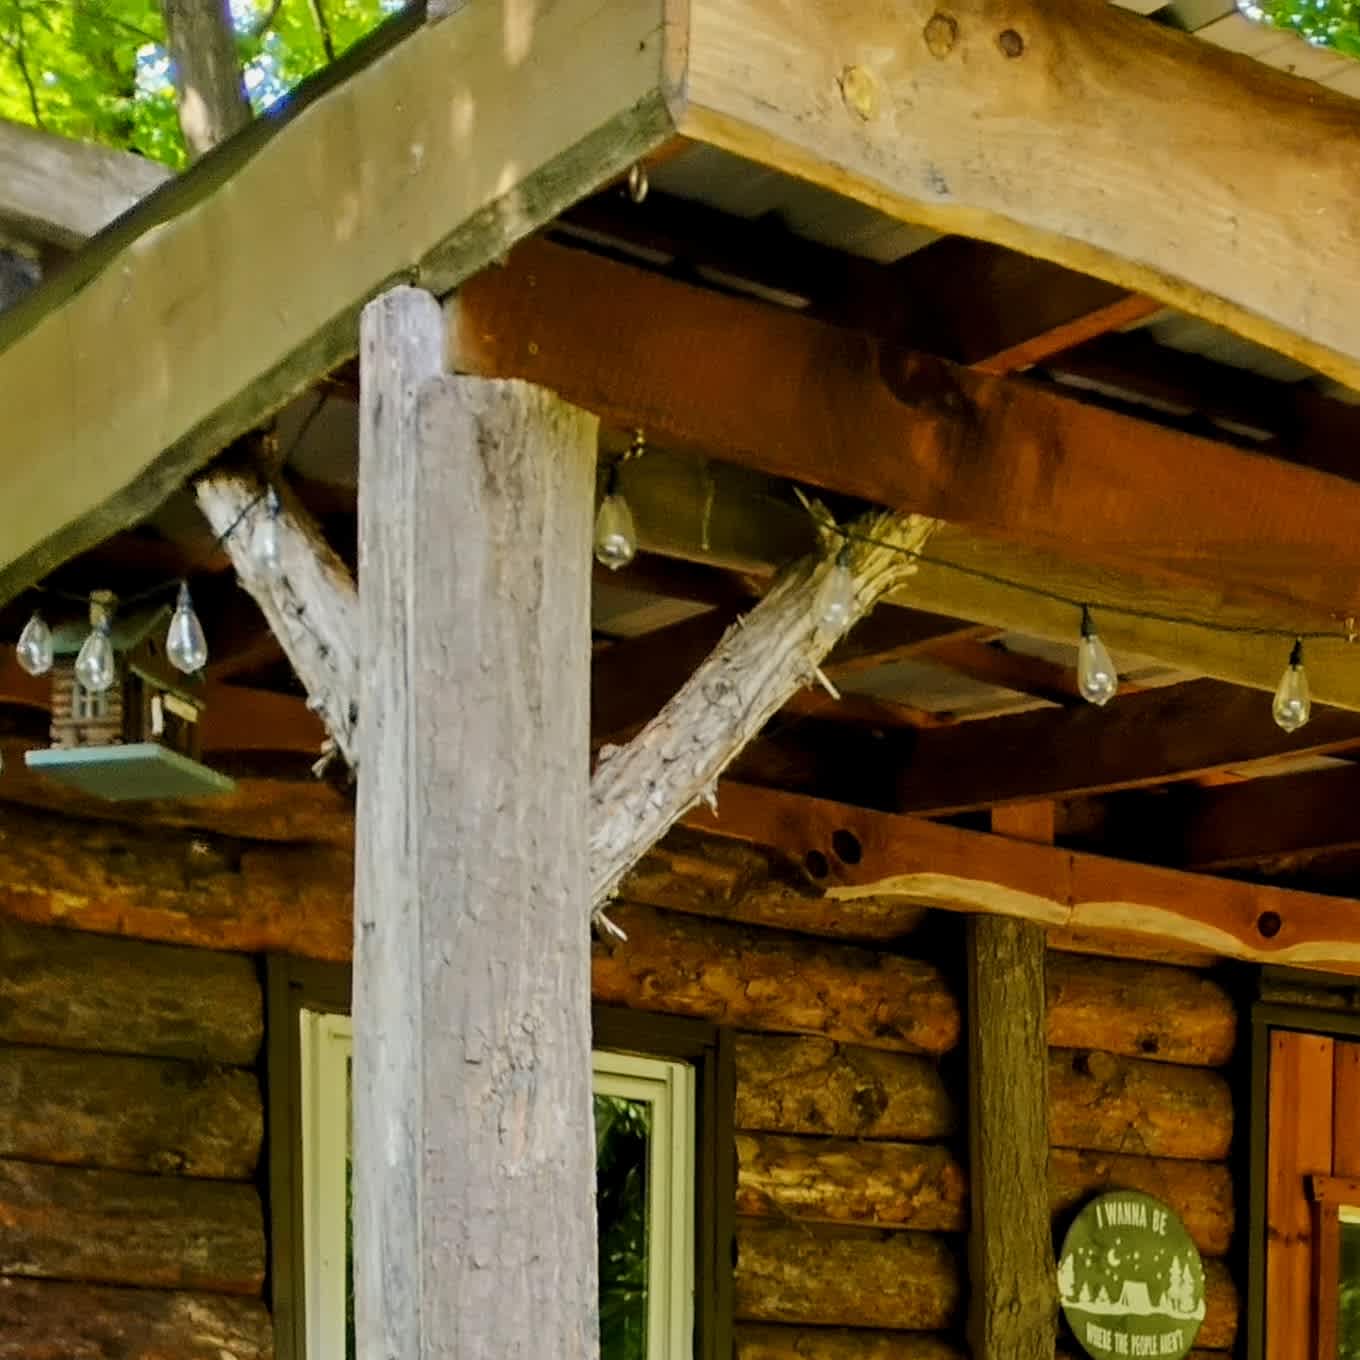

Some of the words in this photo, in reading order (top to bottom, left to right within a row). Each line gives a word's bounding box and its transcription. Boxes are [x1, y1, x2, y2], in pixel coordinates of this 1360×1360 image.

[1096, 1205, 1103, 1229] I
[1105, 1201, 1147, 1228] WANNA
[1152, 1209, 1168, 1236] BE
[1086, 1321, 1112, 1352] WHERE
[1114, 1331, 1129, 1355] THE
[1131, 1333, 1158, 1356] PEOPLE
[1159, 1328, 1183, 1354] AREN'T
